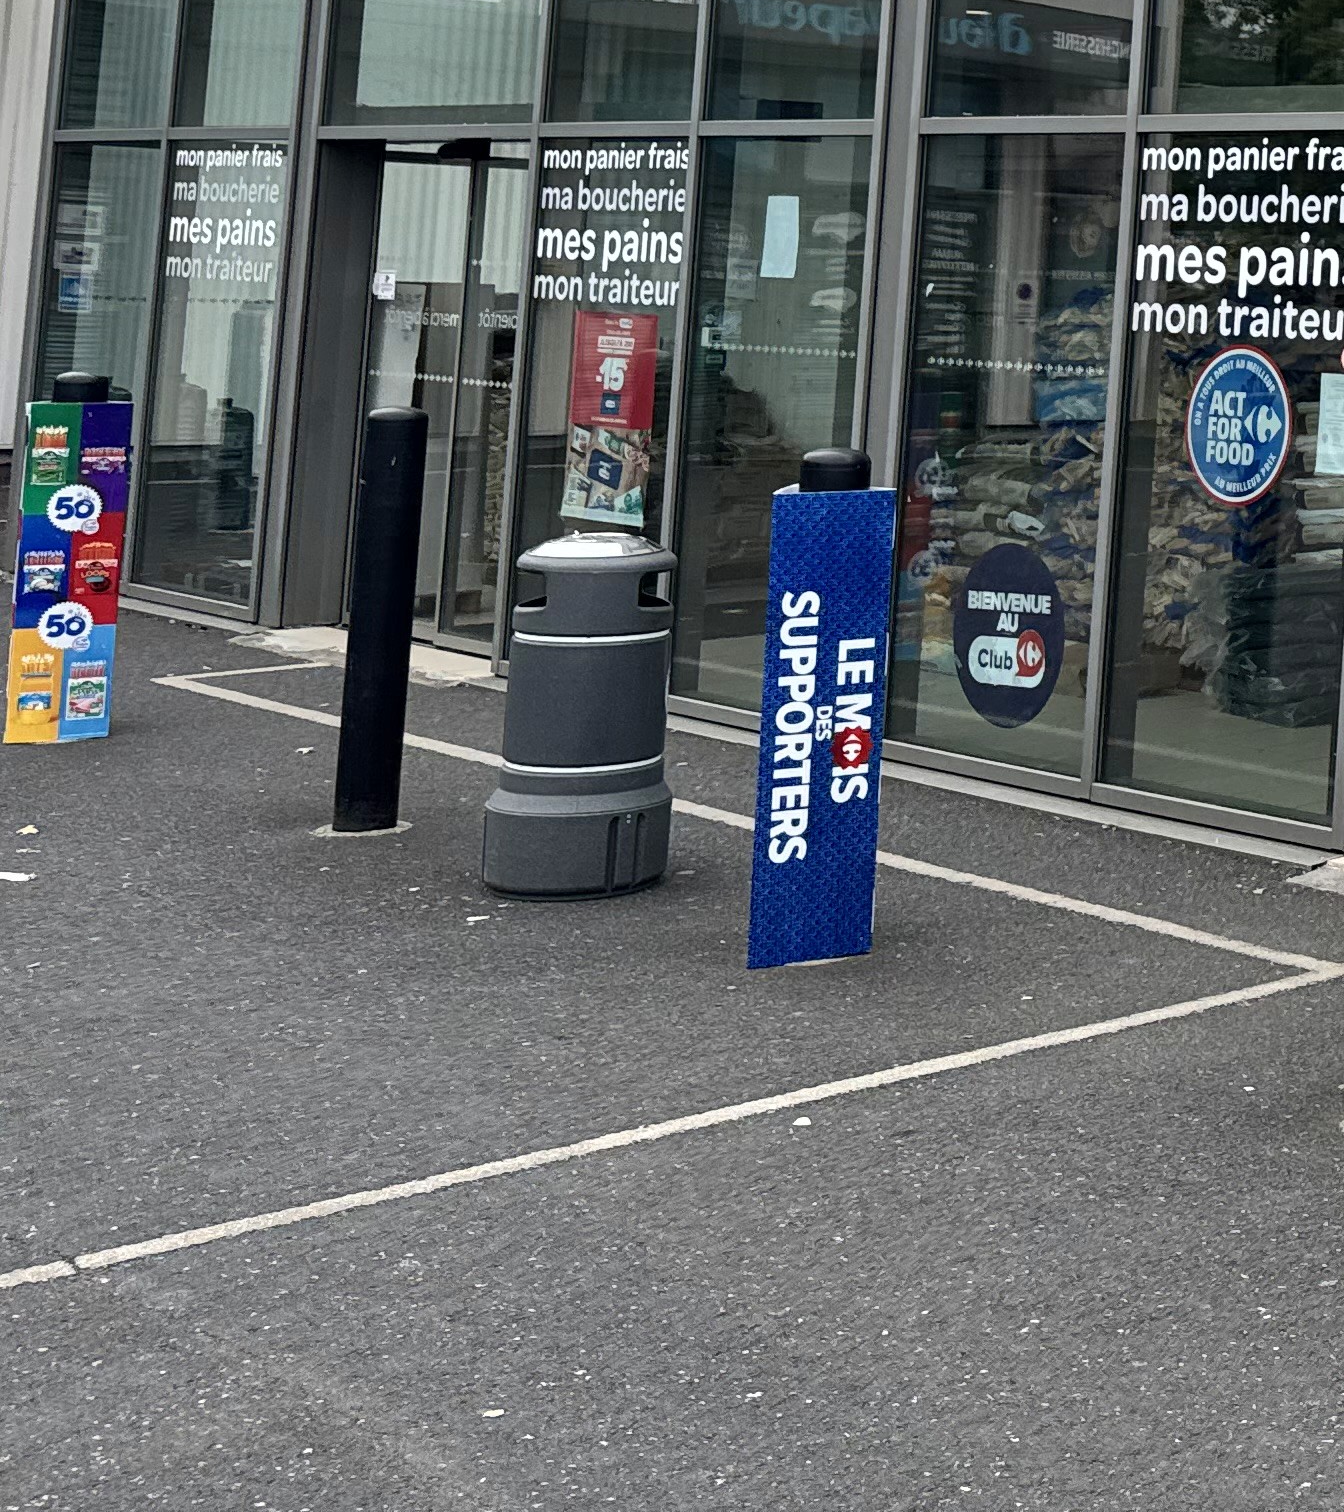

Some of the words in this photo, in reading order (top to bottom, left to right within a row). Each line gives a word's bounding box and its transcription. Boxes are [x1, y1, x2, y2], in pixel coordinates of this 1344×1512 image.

[544, 149, 582, 169] mon
[585, 142, 644, 175] panier
[1142, 146, 1201, 172] mon
[1207, 138, 1299, 179] panier
[200, 175, 279, 203] boucherie
[542, 187, 572, 210] ma
[578, 179, 685, 212] boucherie
[1140, 192, 1188, 221] ma
[169, 216, 212, 243] mes
[216, 208, 276, 253] pains
[537, 228, 596, 260] mes
[602, 218, 683, 272] pains
[1136, 243, 1227, 284] mes
[533, 274, 582, 301] mon
[589, 268, 680, 306] traiteur
[1132, 300, 1207, 334] mon
[1209, 390, 1246, 416] ACT
[1207, 416, 1242, 441] FOR
[1206, 440, 1254, 466] FOOD
[967, 590, 1051, 614] BIENVENUE
[837, 638, 875, 685] LE
[978, 648, 1013, 670] Club
[768, 590, 820, 864] SUPPORTERS
